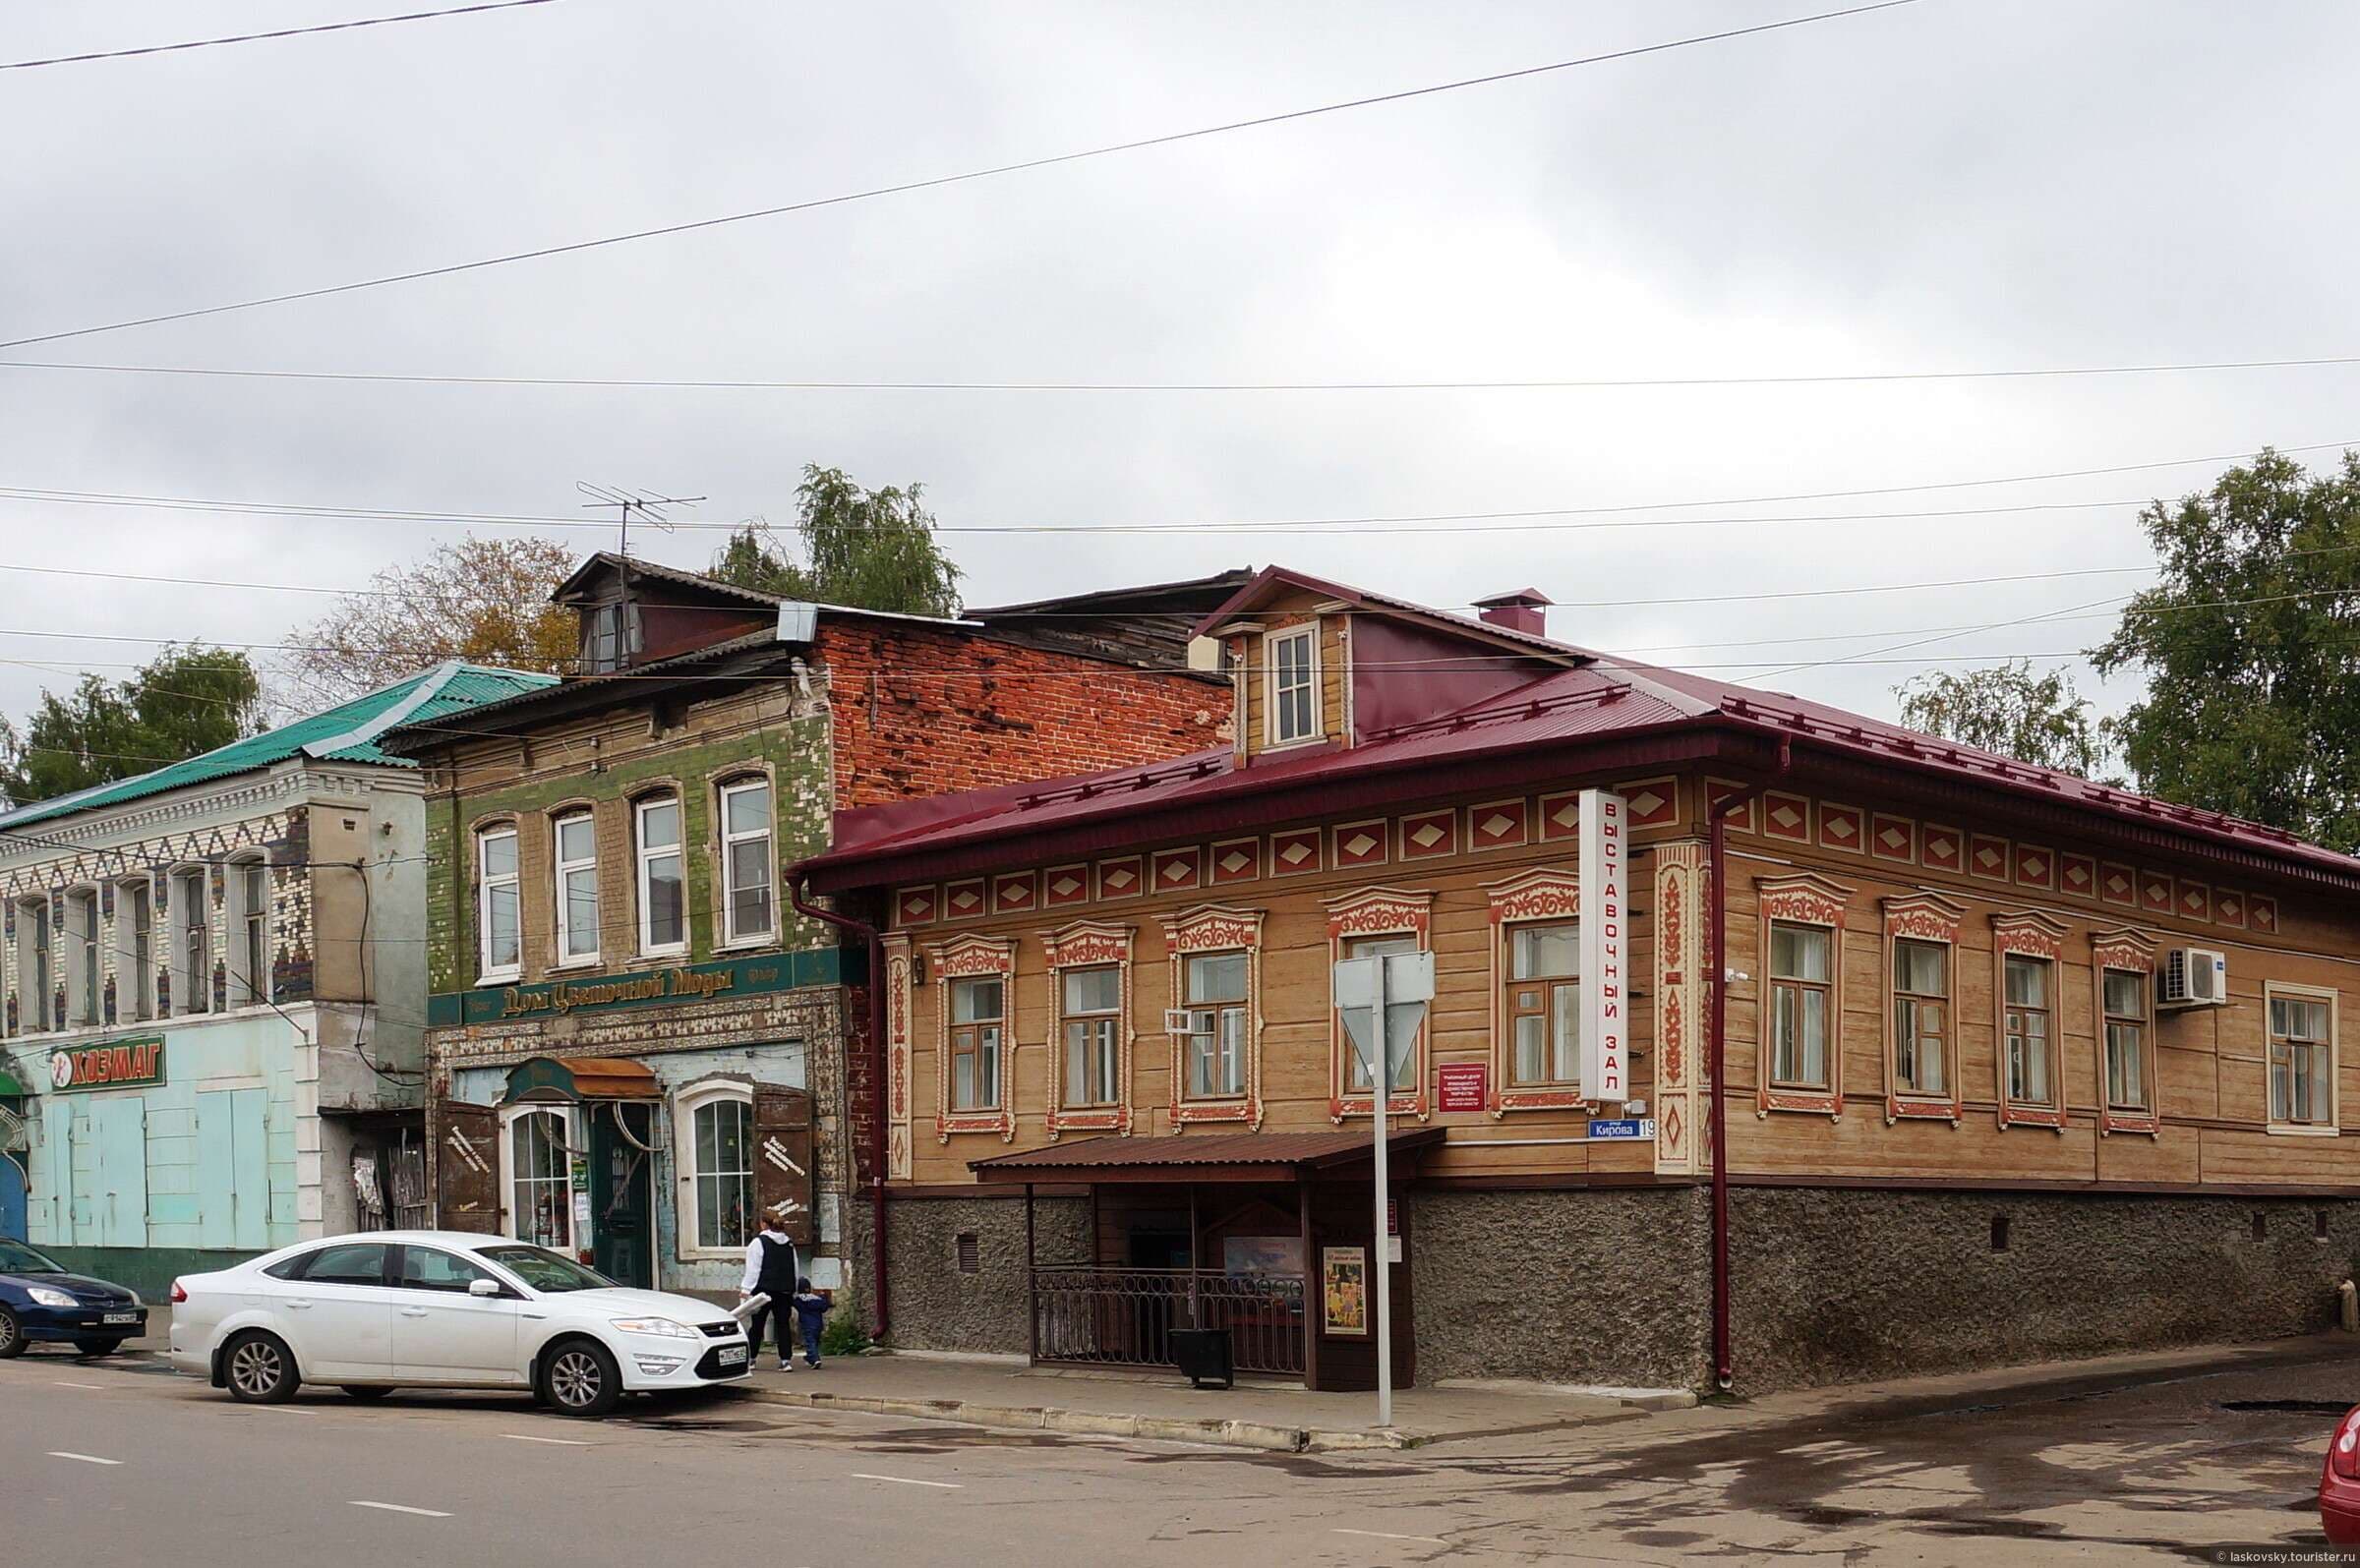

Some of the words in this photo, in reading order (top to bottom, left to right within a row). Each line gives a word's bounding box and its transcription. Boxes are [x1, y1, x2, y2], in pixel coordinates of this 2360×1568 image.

[1604, 802, 1619, 1018] ВЫСТАВОЧНЫЙ
[502, 986, 549, 1017] Дом
[552, 971, 665, 1014] Цветочной
[670, 967, 733, 998] Моды
[71, 1043, 160, 1085] ХОЗМАГ
[1604, 1035, 1619, 1089] ЗАЛ
[1596, 1125, 1633, 1136] Кирова
[1642, 1120, 1655, 1135] 19
